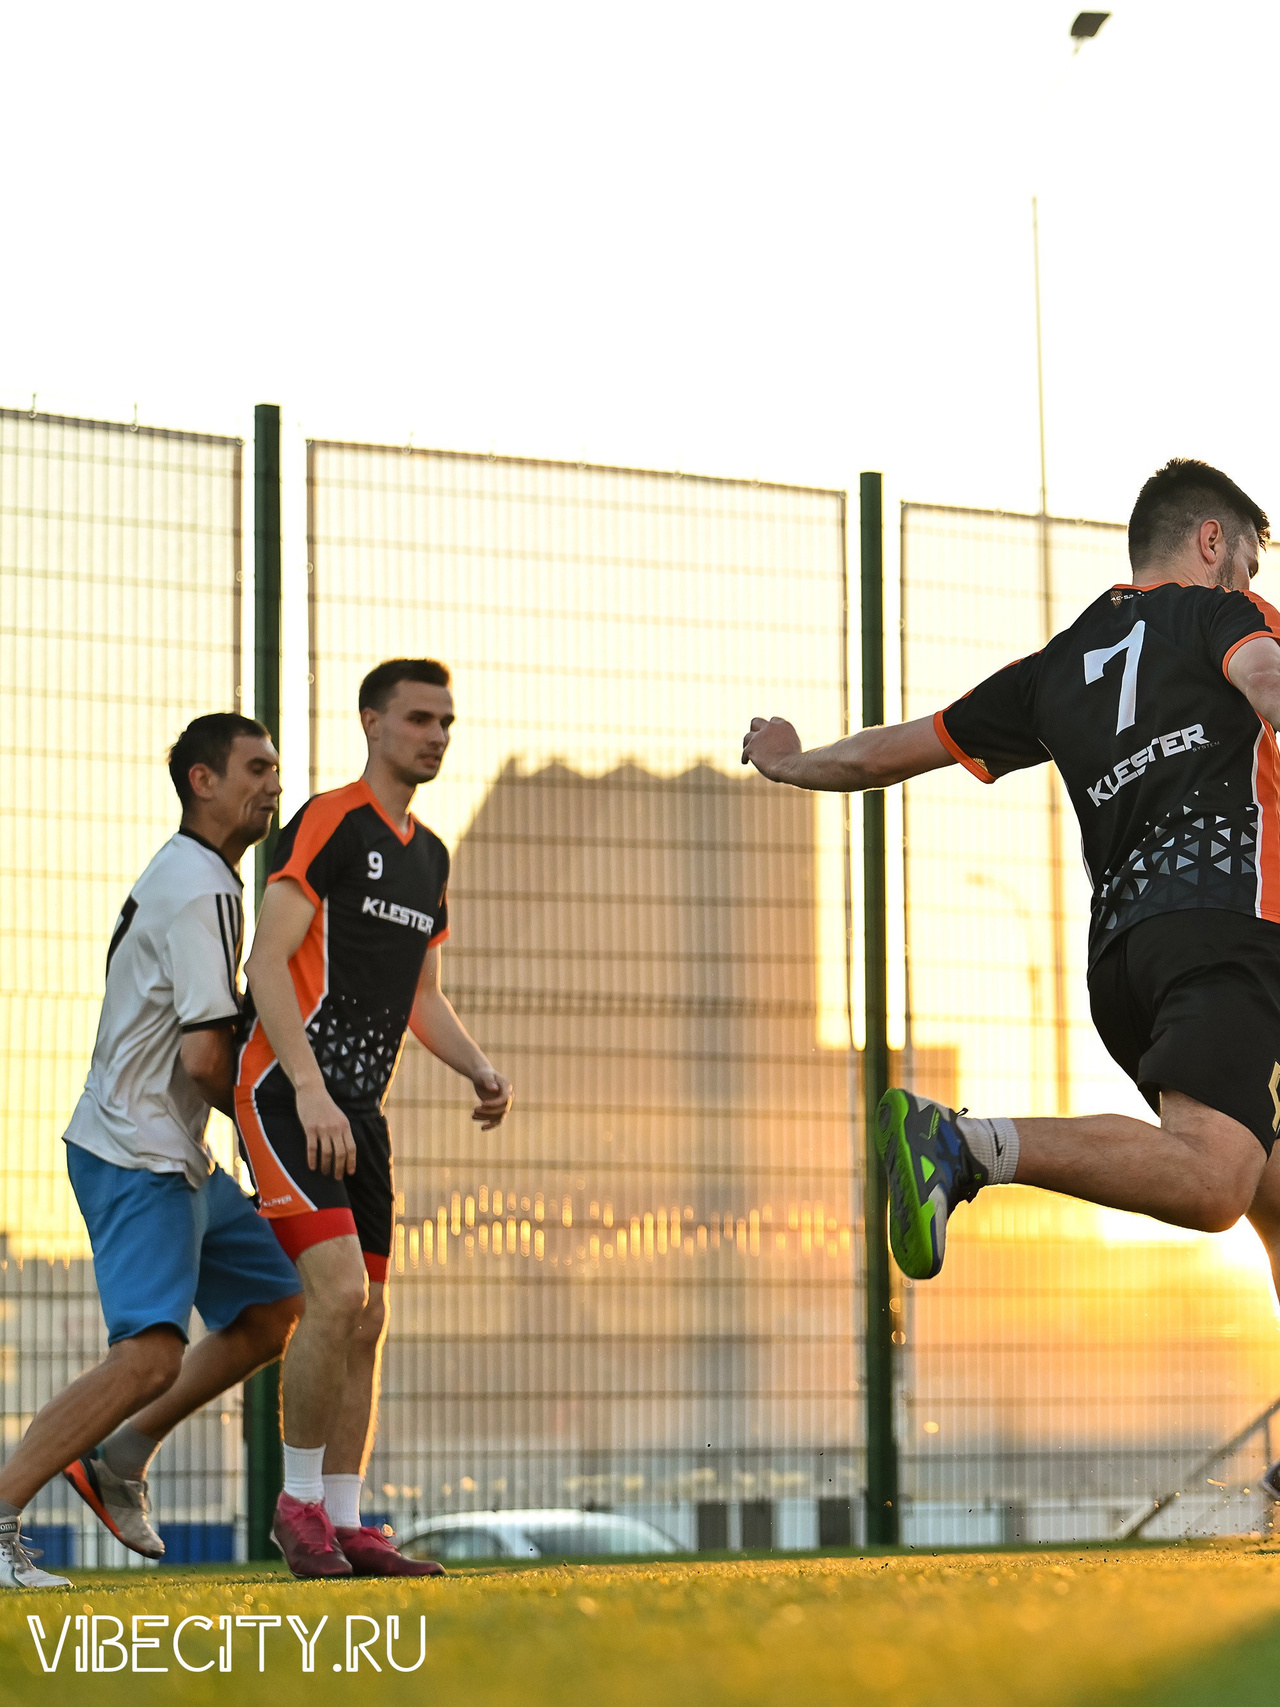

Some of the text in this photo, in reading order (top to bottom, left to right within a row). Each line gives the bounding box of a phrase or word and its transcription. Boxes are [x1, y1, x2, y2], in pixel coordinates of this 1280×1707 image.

[1083, 620, 1145, 736] 7
[1086, 723, 1210, 808] KLESTER
[367, 851, 384, 880] 9
[362, 895, 435, 936] KLESTER
